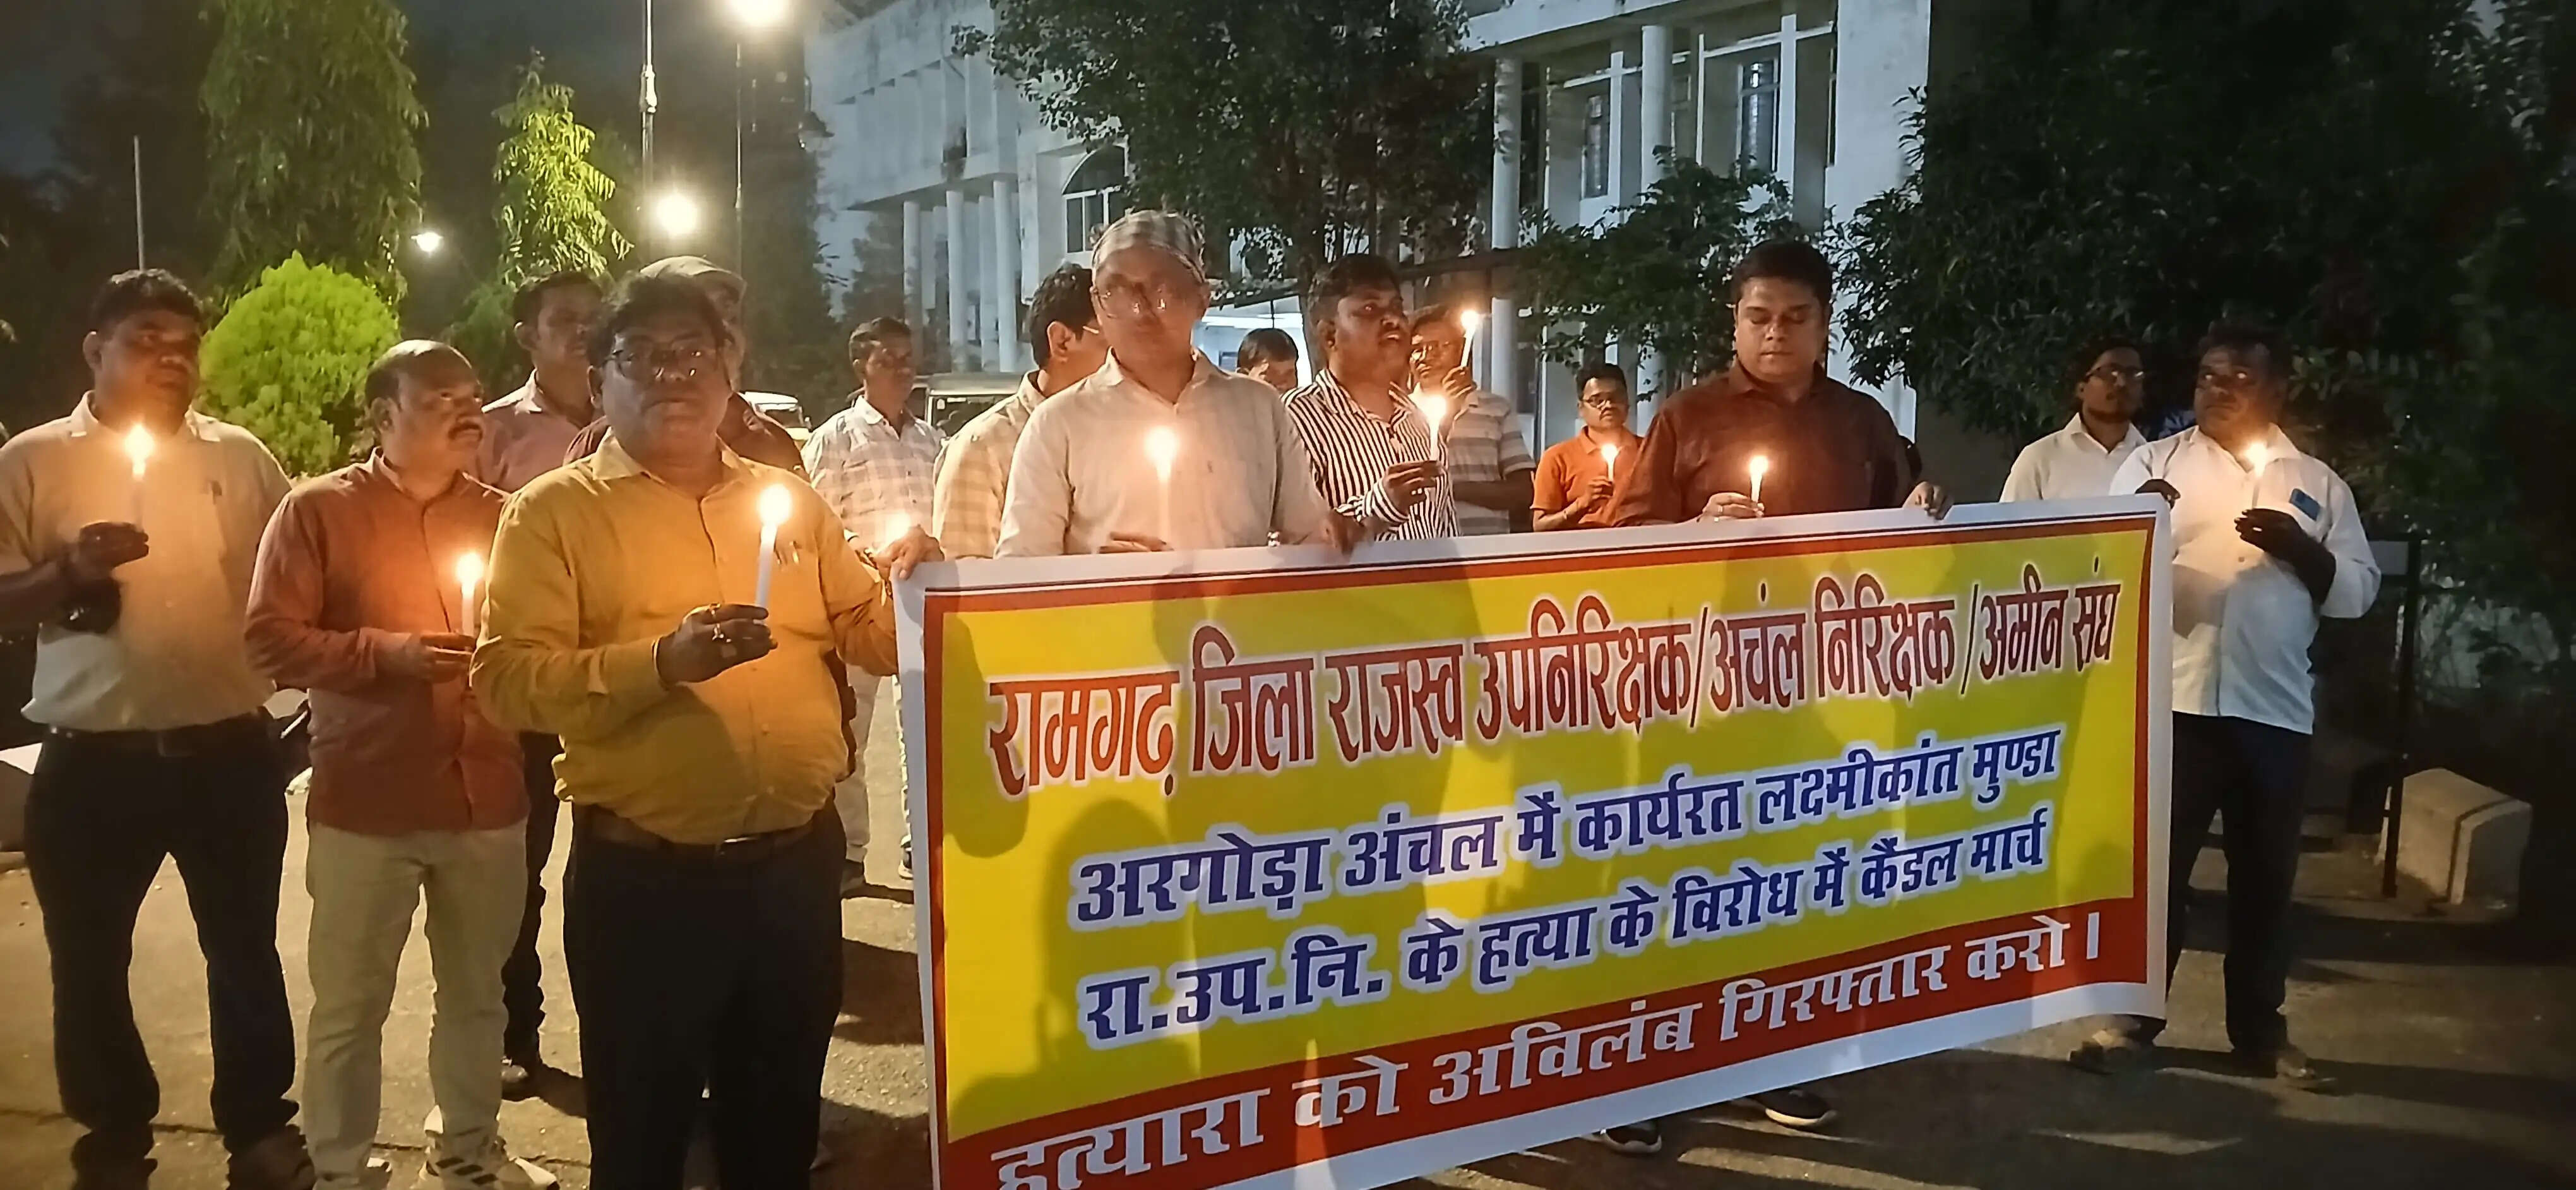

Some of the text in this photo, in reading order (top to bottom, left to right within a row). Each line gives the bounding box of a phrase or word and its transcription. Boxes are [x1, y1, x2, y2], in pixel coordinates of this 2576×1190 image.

[989, 671, 1180, 796] रामगढ़
[1192, 625, 1314, 772] जिला
[1327, 644, 1464, 762] राजस्व
[1815, 574, 1955, 701] निरिक्षक
[2073, 556, 2121, 671] संघ
[1077, 729, 2061, 922] अरगोड़ा अंचल में कार्यरत लक्ष्मीकांत मुण्डा
[1407, 919, 1464, 984] के
[1479, 906, 1597, 984] हत्या
[1609, 886, 1660, 948] के
[1672, 866, 1804, 939] विरोध
[1813, 847, 1850, 907] में
[1861, 835, 1964, 900] कैंडल
[1971, 808, 2047, 873] मार्च
[1292, 1057, 1407, 1129] को
[1429, 1001, 1703, 1104] अविलंब
[1720, 945, 1951, 1043] गिरफ्तार
[1965, 918, 2071, 981] करो
